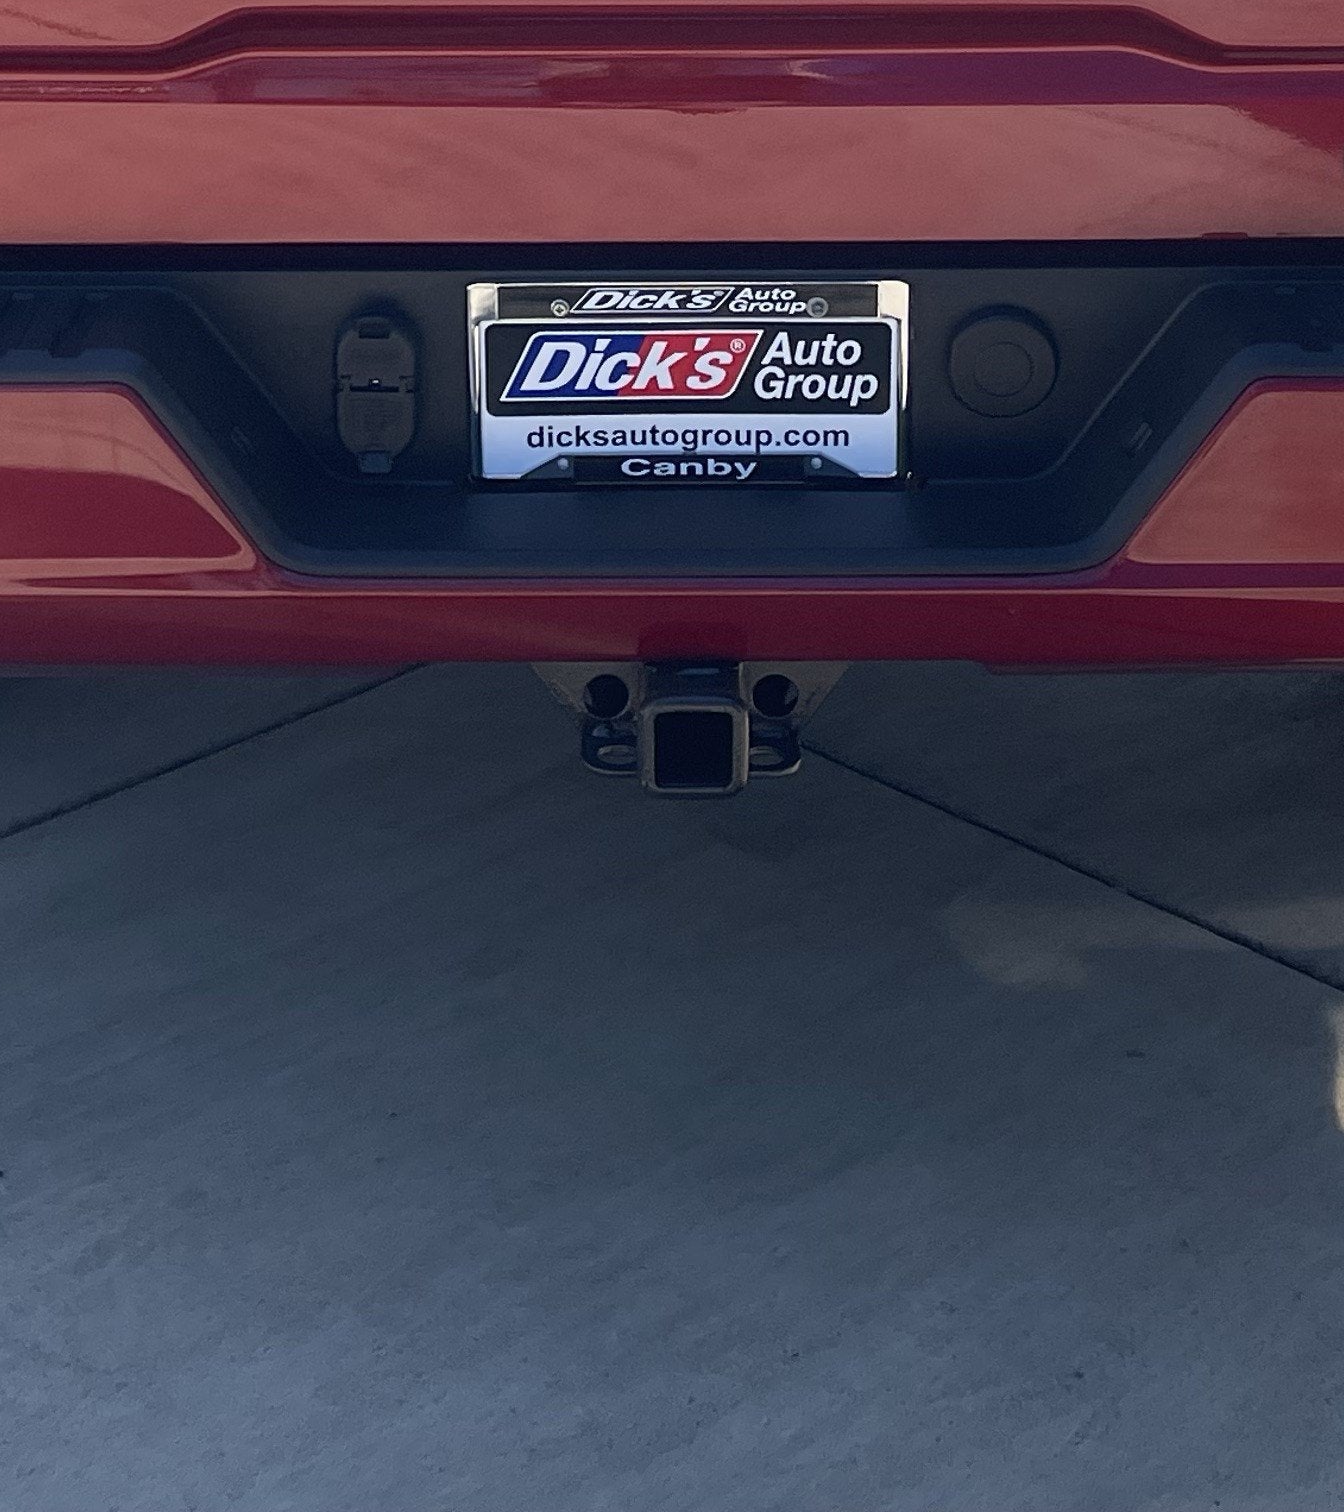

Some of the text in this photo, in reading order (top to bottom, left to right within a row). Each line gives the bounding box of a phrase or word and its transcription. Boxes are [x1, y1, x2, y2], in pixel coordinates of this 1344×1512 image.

[581, 288, 718, 312] Dick's
[727, 299, 807, 314] Group
[734, 287, 798, 301] Auto
[760, 331, 863, 367] Auto
[518, 337, 732, 392] Dick's
[753, 368, 879, 407] Group
[526, 424, 851, 454] dicksautogroup.com
[620, 456, 758, 480] Canby
